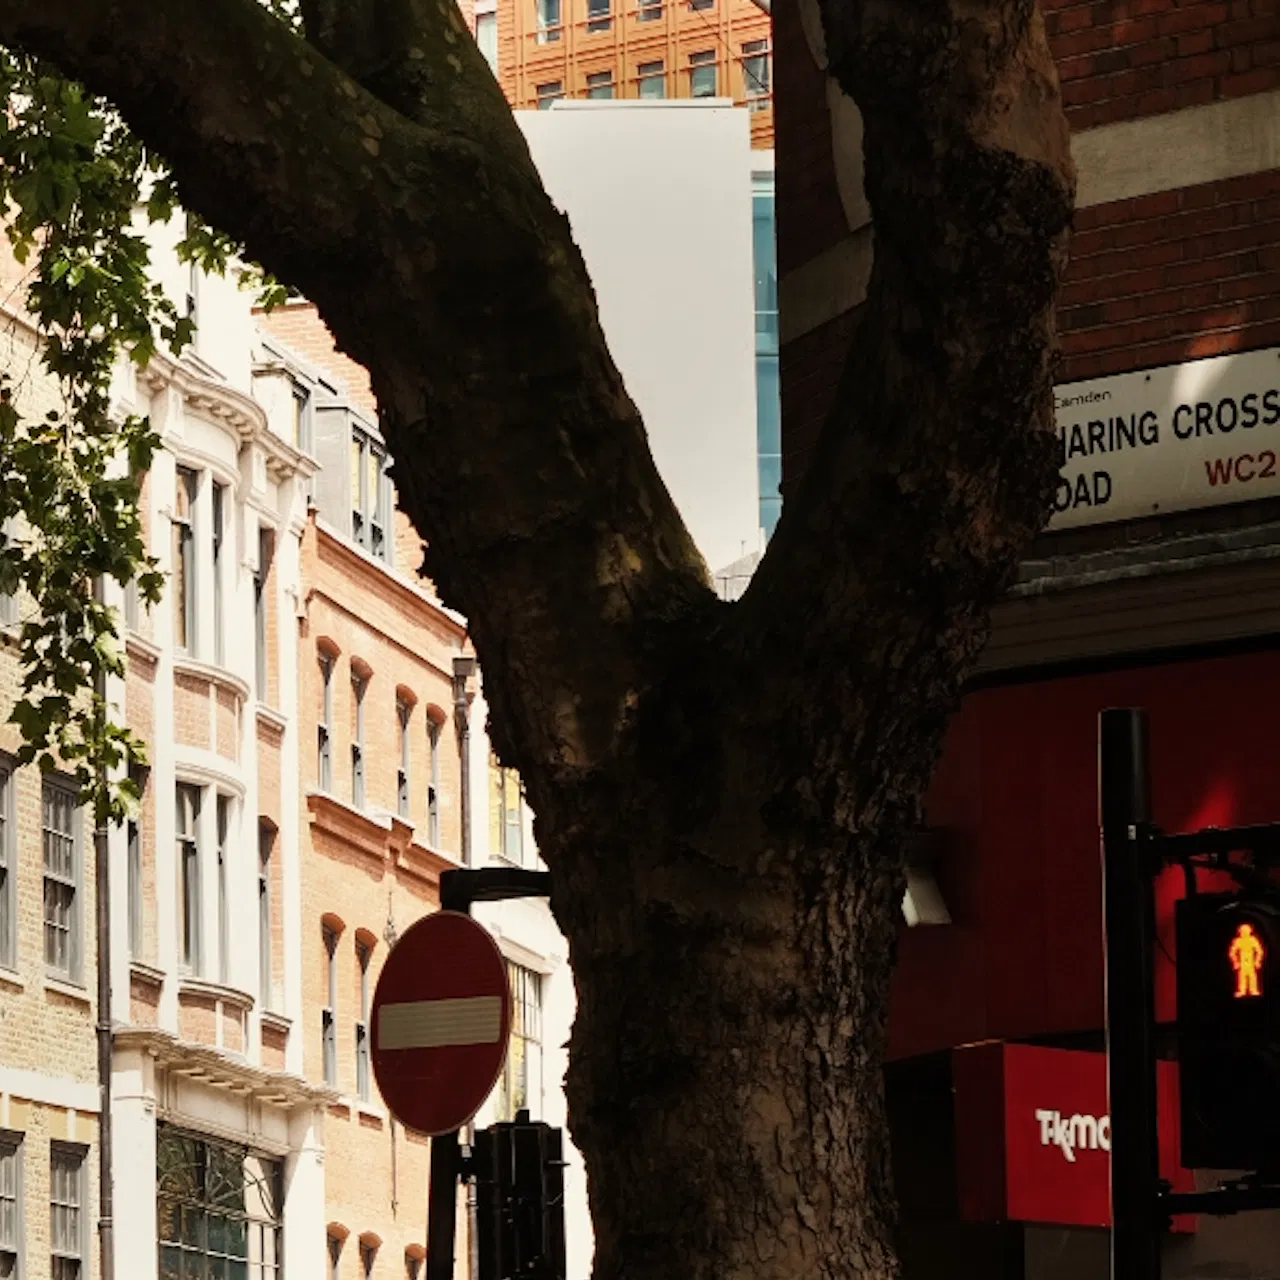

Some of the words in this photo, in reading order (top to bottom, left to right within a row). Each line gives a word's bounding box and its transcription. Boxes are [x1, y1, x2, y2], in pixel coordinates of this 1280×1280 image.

[1173, 389, 1280, 440] CROSS
[1205, 450, 1276, 486] WC2
[1054, 471, 1112, 512] OAD
